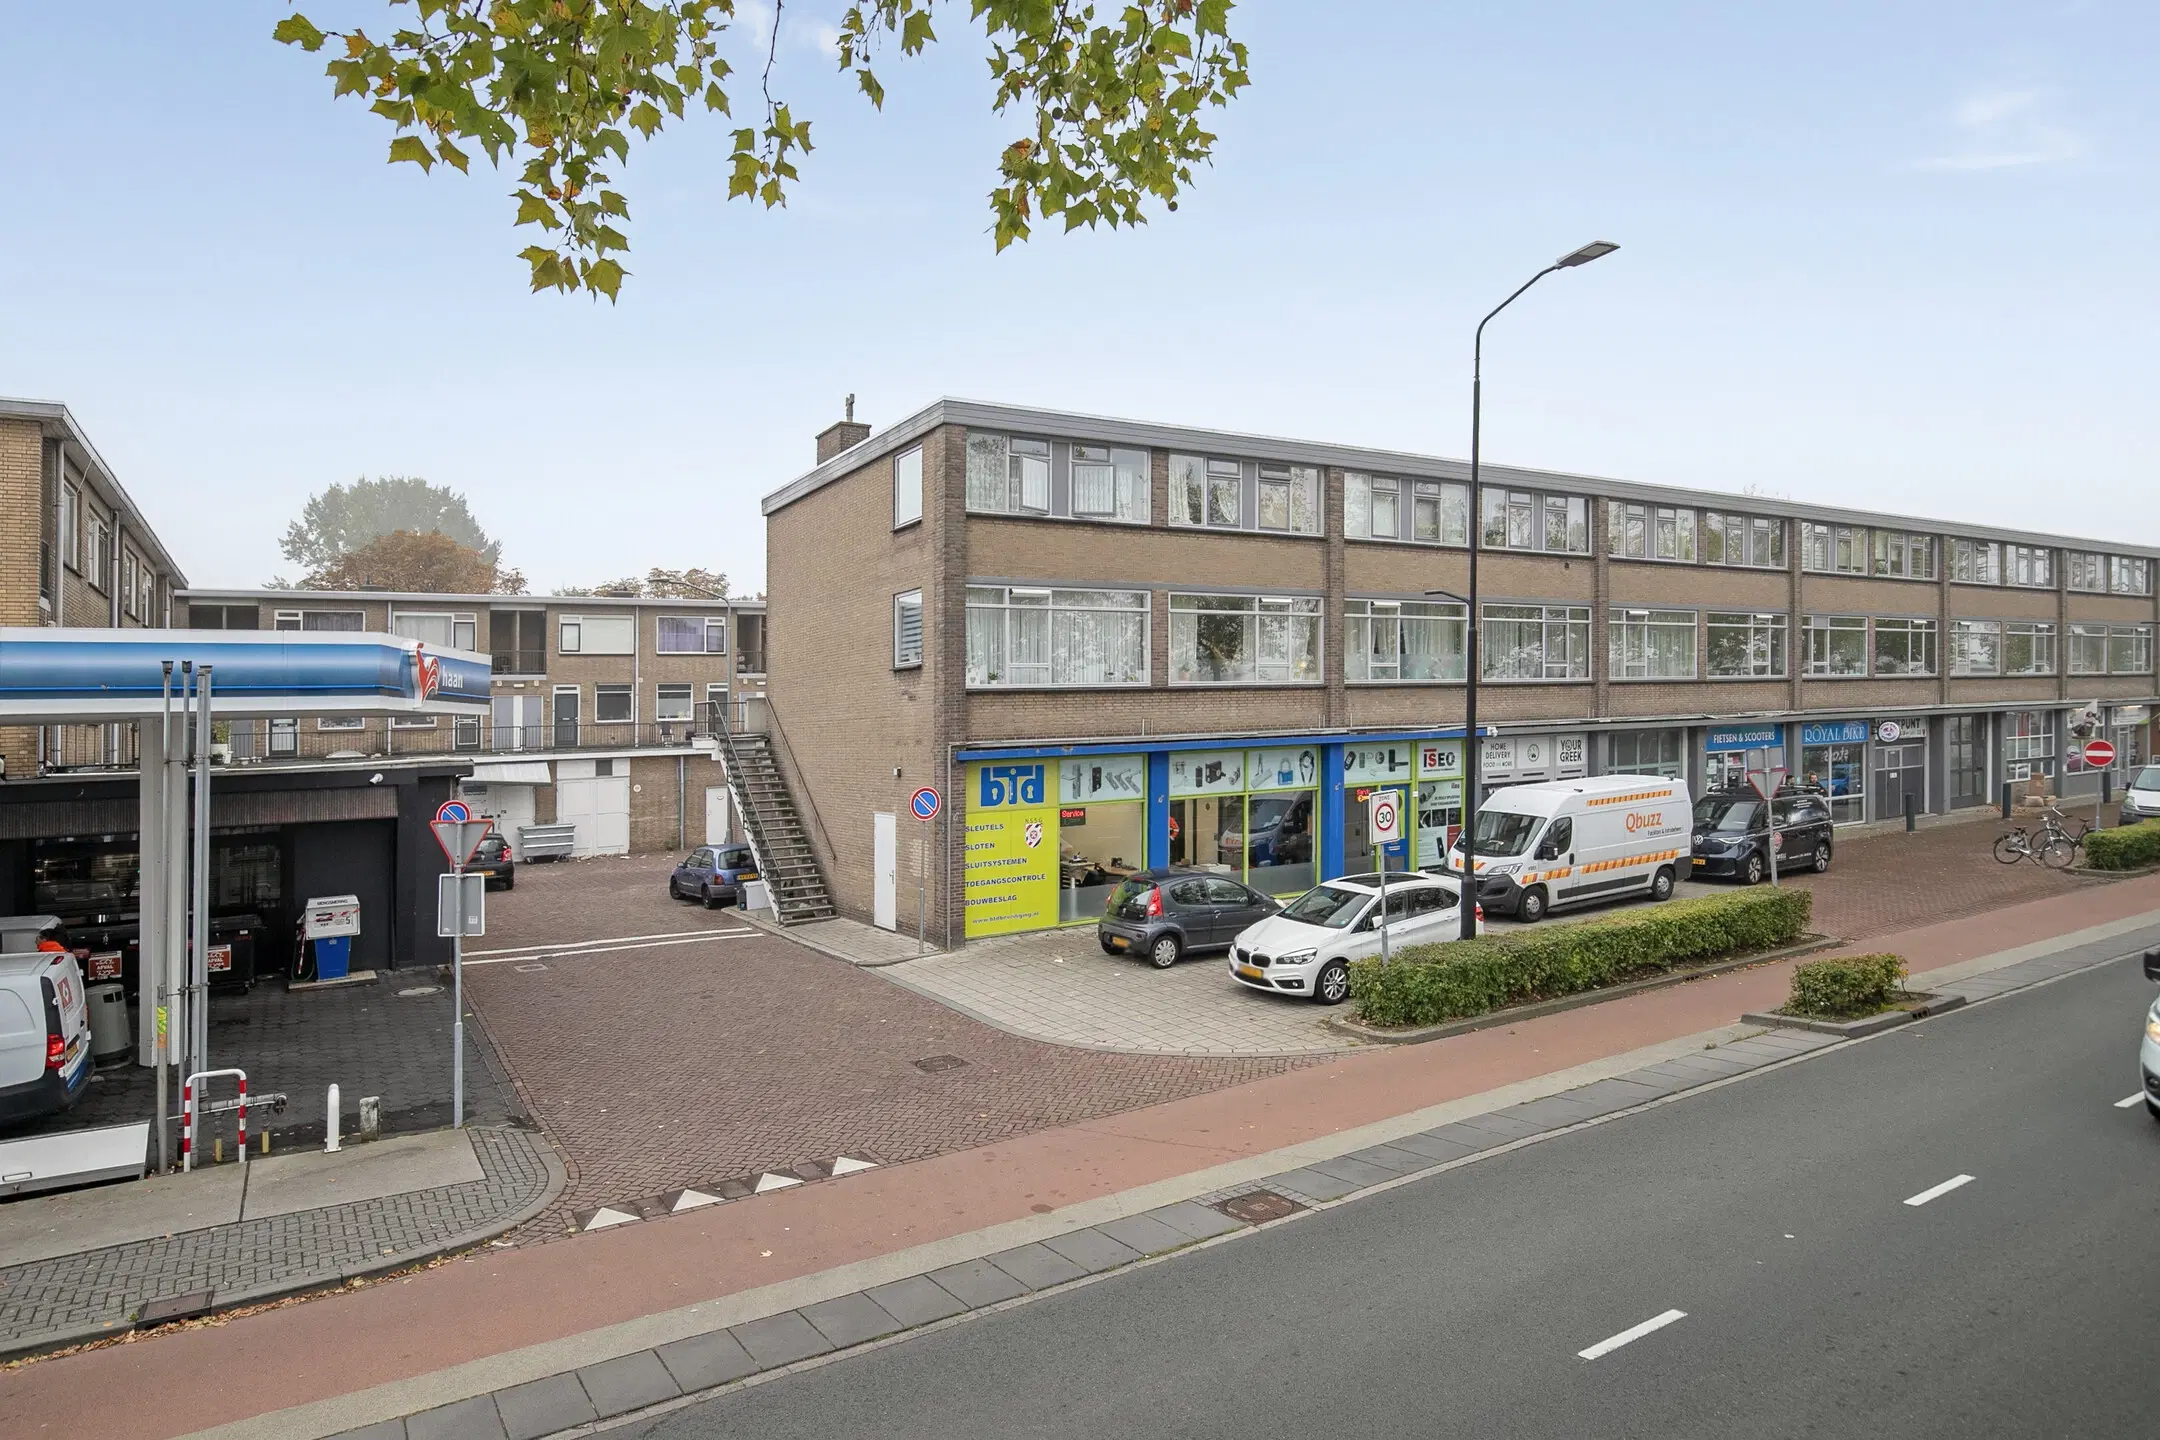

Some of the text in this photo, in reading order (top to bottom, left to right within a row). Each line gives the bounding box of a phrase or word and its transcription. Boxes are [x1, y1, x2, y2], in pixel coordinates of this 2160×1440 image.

[442, 665, 463, 688] haan
[1713, 734, 1737, 744] FIETSEN
[1745, 731, 1775, 742] SCOOTERS
[1805, 727, 1865, 742] ROYAL BIKE
[1560, 740, 1582, 751] YOUR
[1424, 751, 1455, 768] ISEO
[1560, 751, 1582, 762] GREEK
[1379, 811, 1391, 823] 30
[1626, 813, 1662, 832] Qbuzz
[965, 824, 1004, 832] SLEUTELS
[966, 843, 995, 851] SLOTEN
[965, 858, 1027, 869] SLUITSYSTEMEN
[966, 874, 1046, 887] TOEGANGSCONTROLE
[964, 895, 1017, 906] BOUWBESLAG
